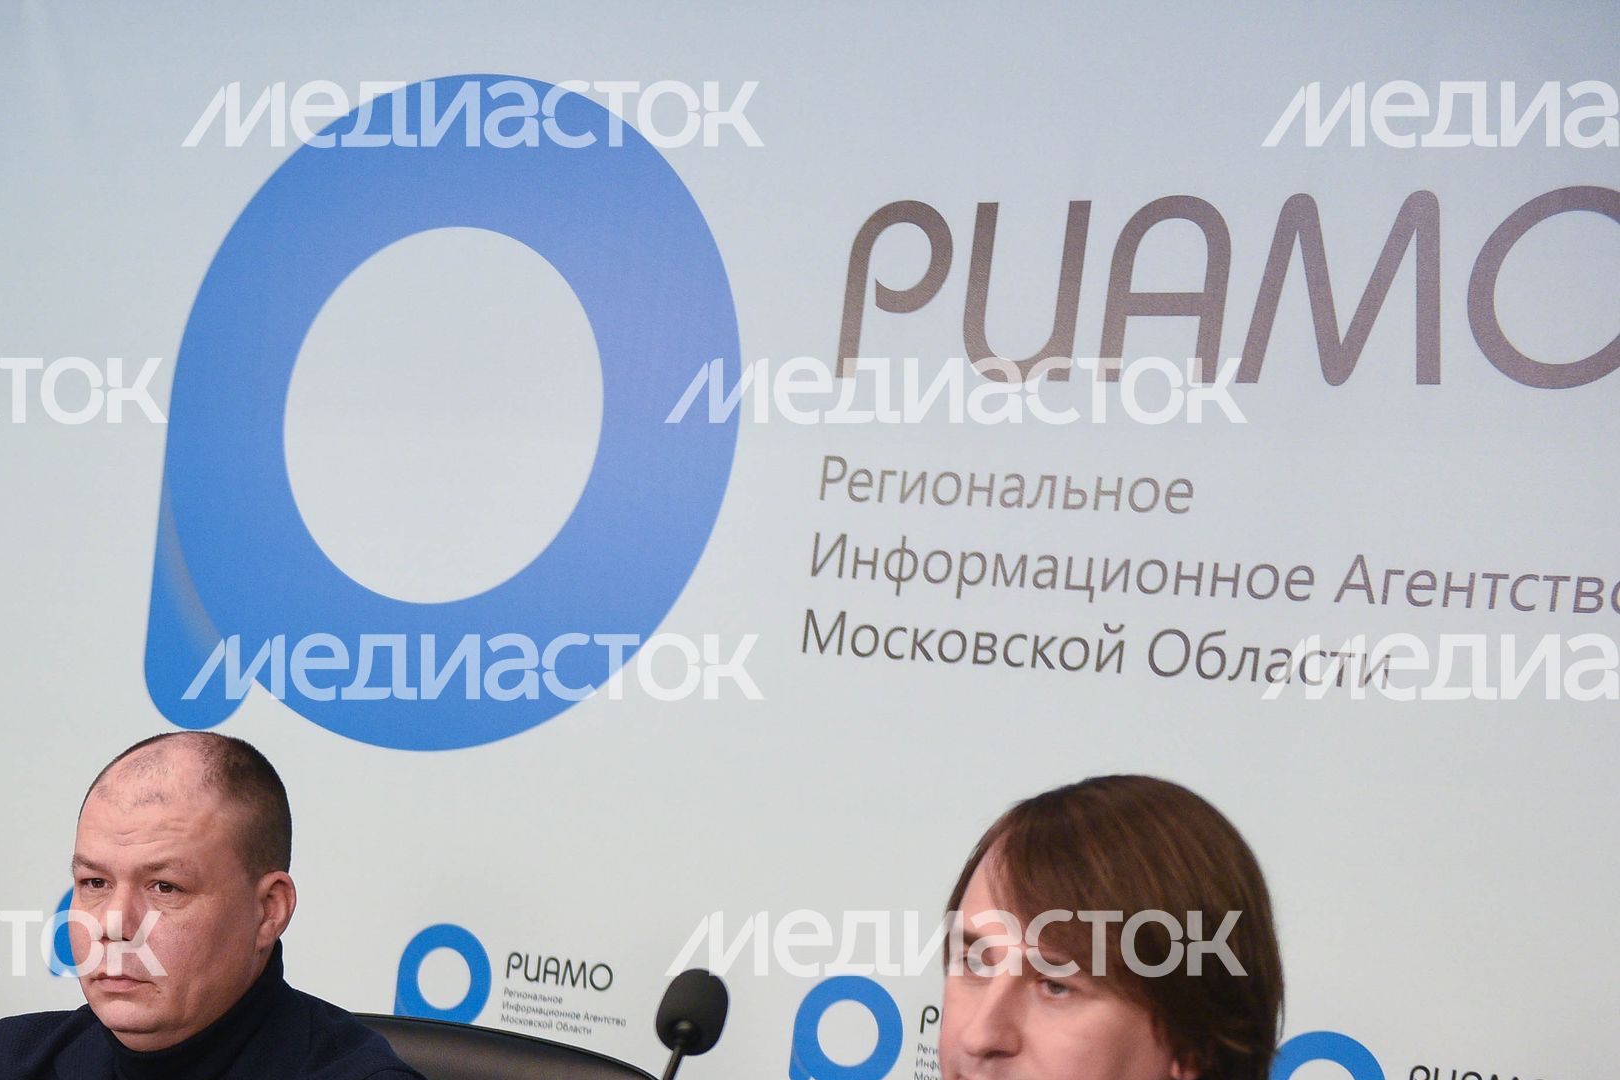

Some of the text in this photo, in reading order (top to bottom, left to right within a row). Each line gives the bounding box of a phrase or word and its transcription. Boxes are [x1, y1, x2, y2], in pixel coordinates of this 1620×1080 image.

[817, 455, 1195, 515] Региональное
[810, 532, 1314, 603] Информационное
[801, 608, 1393, 689] Московской Области
[501, 1001, 627, 1028] Информационное Агентство
[503, 986, 563, 1004] Региональное
[500, 1013, 592, 1036] Московской Области
